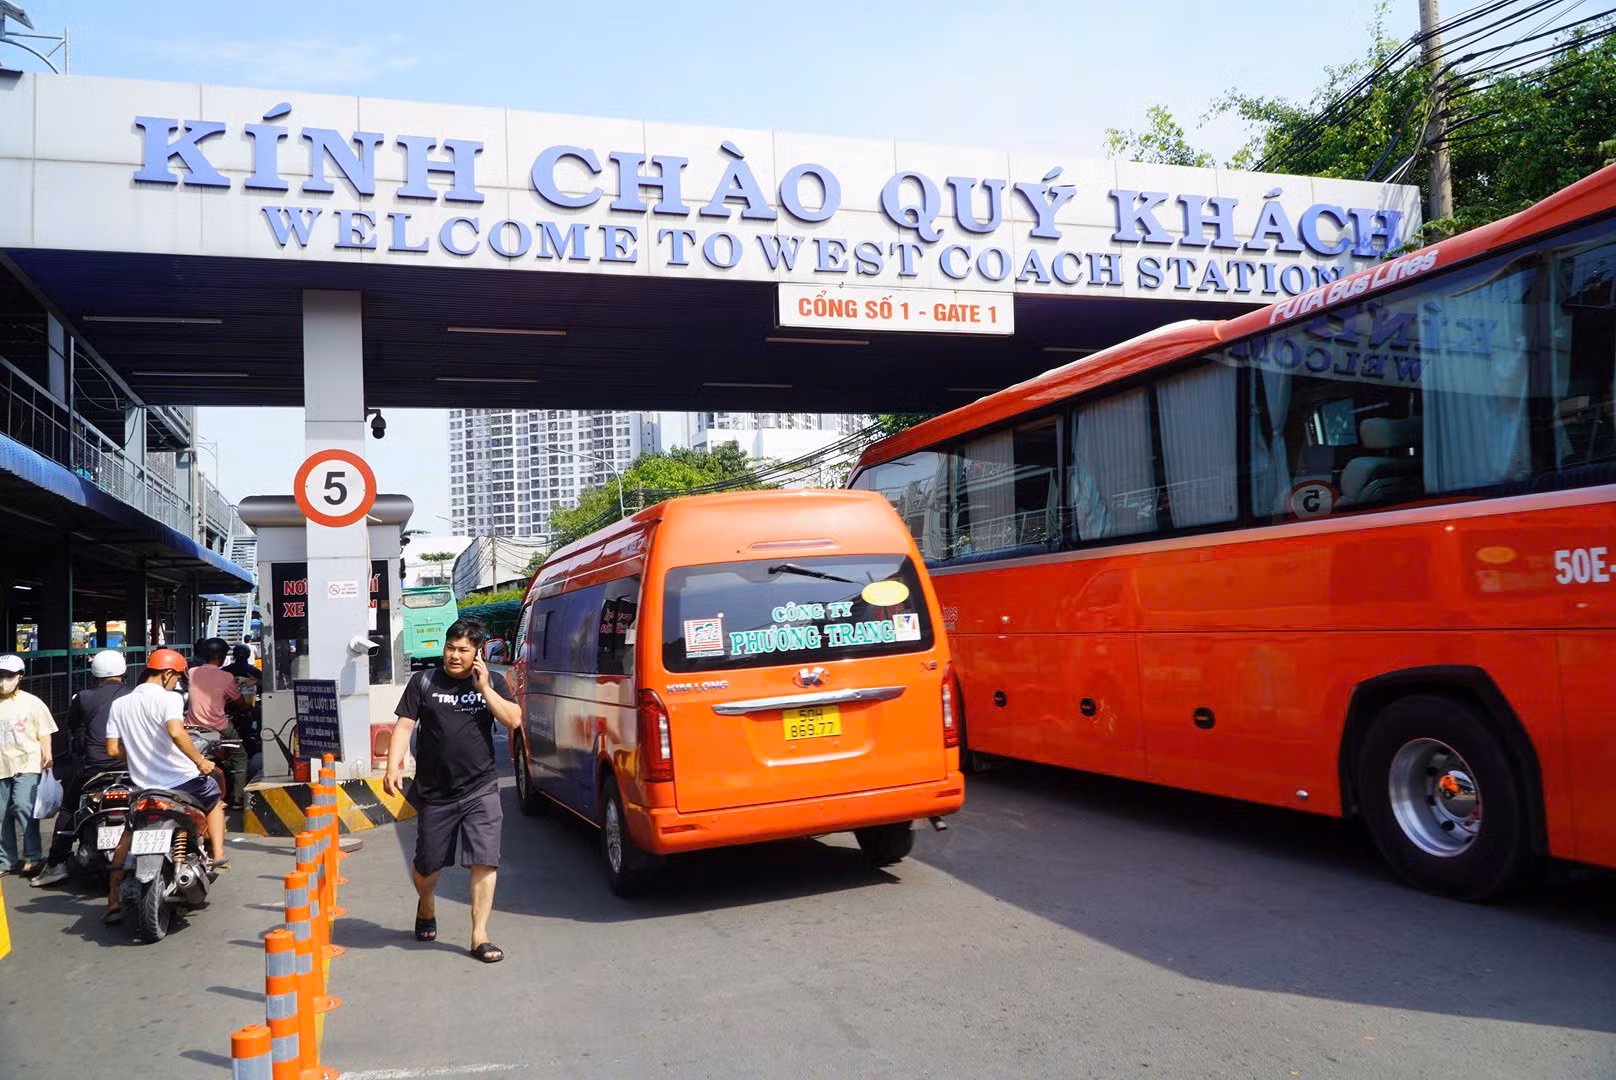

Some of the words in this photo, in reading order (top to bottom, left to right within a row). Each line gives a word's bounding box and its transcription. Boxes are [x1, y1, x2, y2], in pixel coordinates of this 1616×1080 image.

[134, 102, 485, 203] KÍNH
[531, 140, 842, 222] CHÀO
[881, 166, 1077, 243] QUÝ
[1108, 187, 1405, 258] KHÁCH
[261, 206, 638, 263] WELCOME
[659, 228, 743, 268] TO
[756, 234, 926, 276] WEST
[939, 244, 1124, 287] COACH
[1269, 290, 1324, 324] FUTA
[1325, 274, 1371, 305] Bus
[1371, 250, 1439, 289] Lines
[799, 290, 858, 318] CỔNG
[865, 295, 893, 320] SỐ
[900, 302, 909, 320] 1
[933, 303, 981, 323] GATE
[988, 306, 997, 323] 1
[323, 471, 348, 506] 5
[283, 578, 308, 596] NƠ
[283, 602, 305, 617] XE
[772, 601, 826, 623] CÔNG
[828, 601, 854, 618] TY
[729, 624, 822, 656] PHƯƠNG
[823, 619, 896, 648] TRANG
[799, 708, 823, 722] 50H
